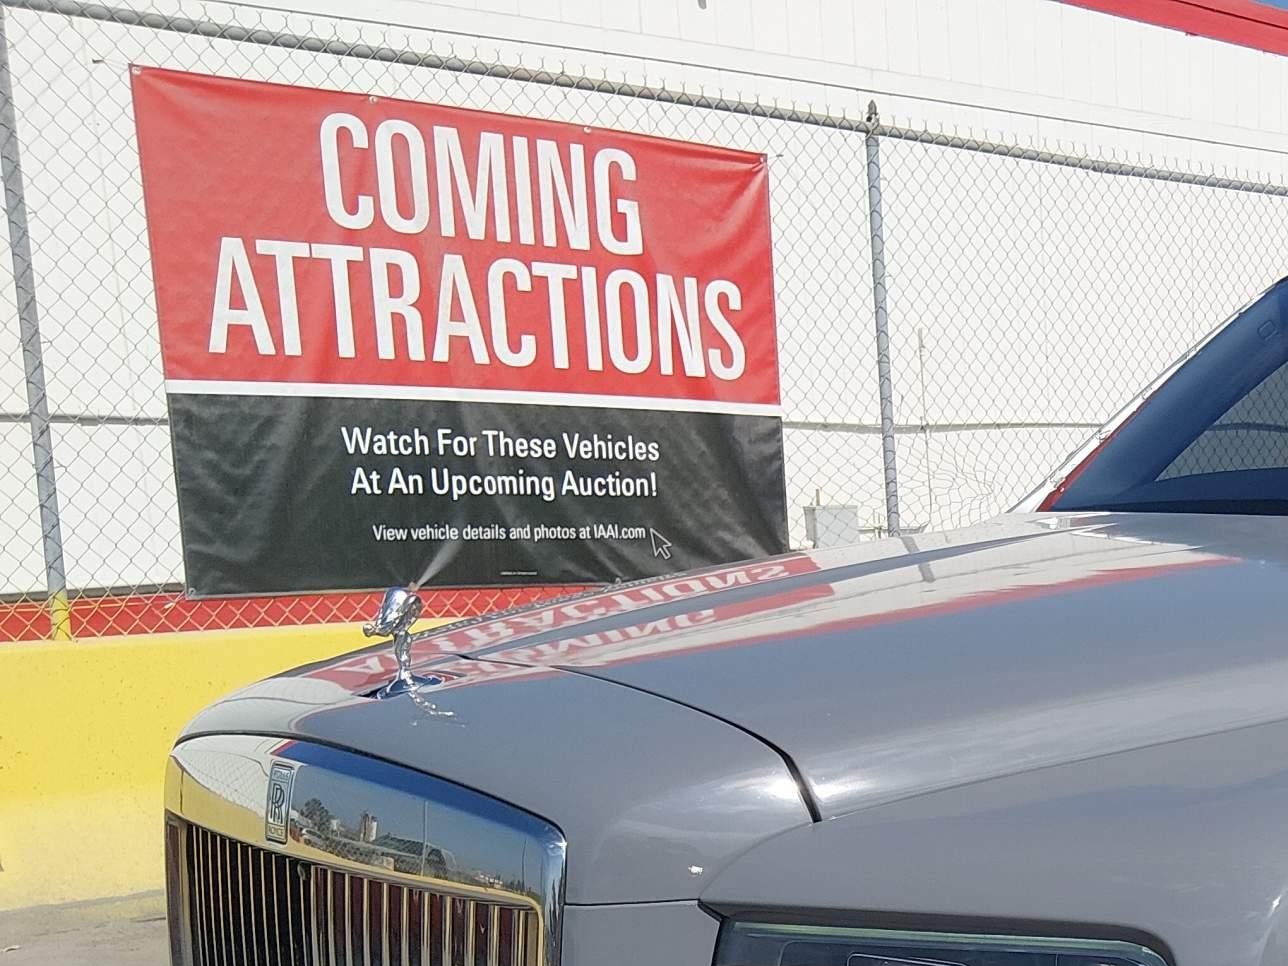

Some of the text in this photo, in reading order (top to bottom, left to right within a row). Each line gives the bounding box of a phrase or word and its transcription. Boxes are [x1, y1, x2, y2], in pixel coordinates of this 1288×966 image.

[319, 112, 645, 256] COMING
[208, 237, 746, 381] ATTRACTIONS
[341, 426, 660, 461] Watch For These Vehicles
[351, 466, 657, 502] At An Upcoming Auction!
[372, 523, 646, 542] View vehicle details and photos at IAAI.com
